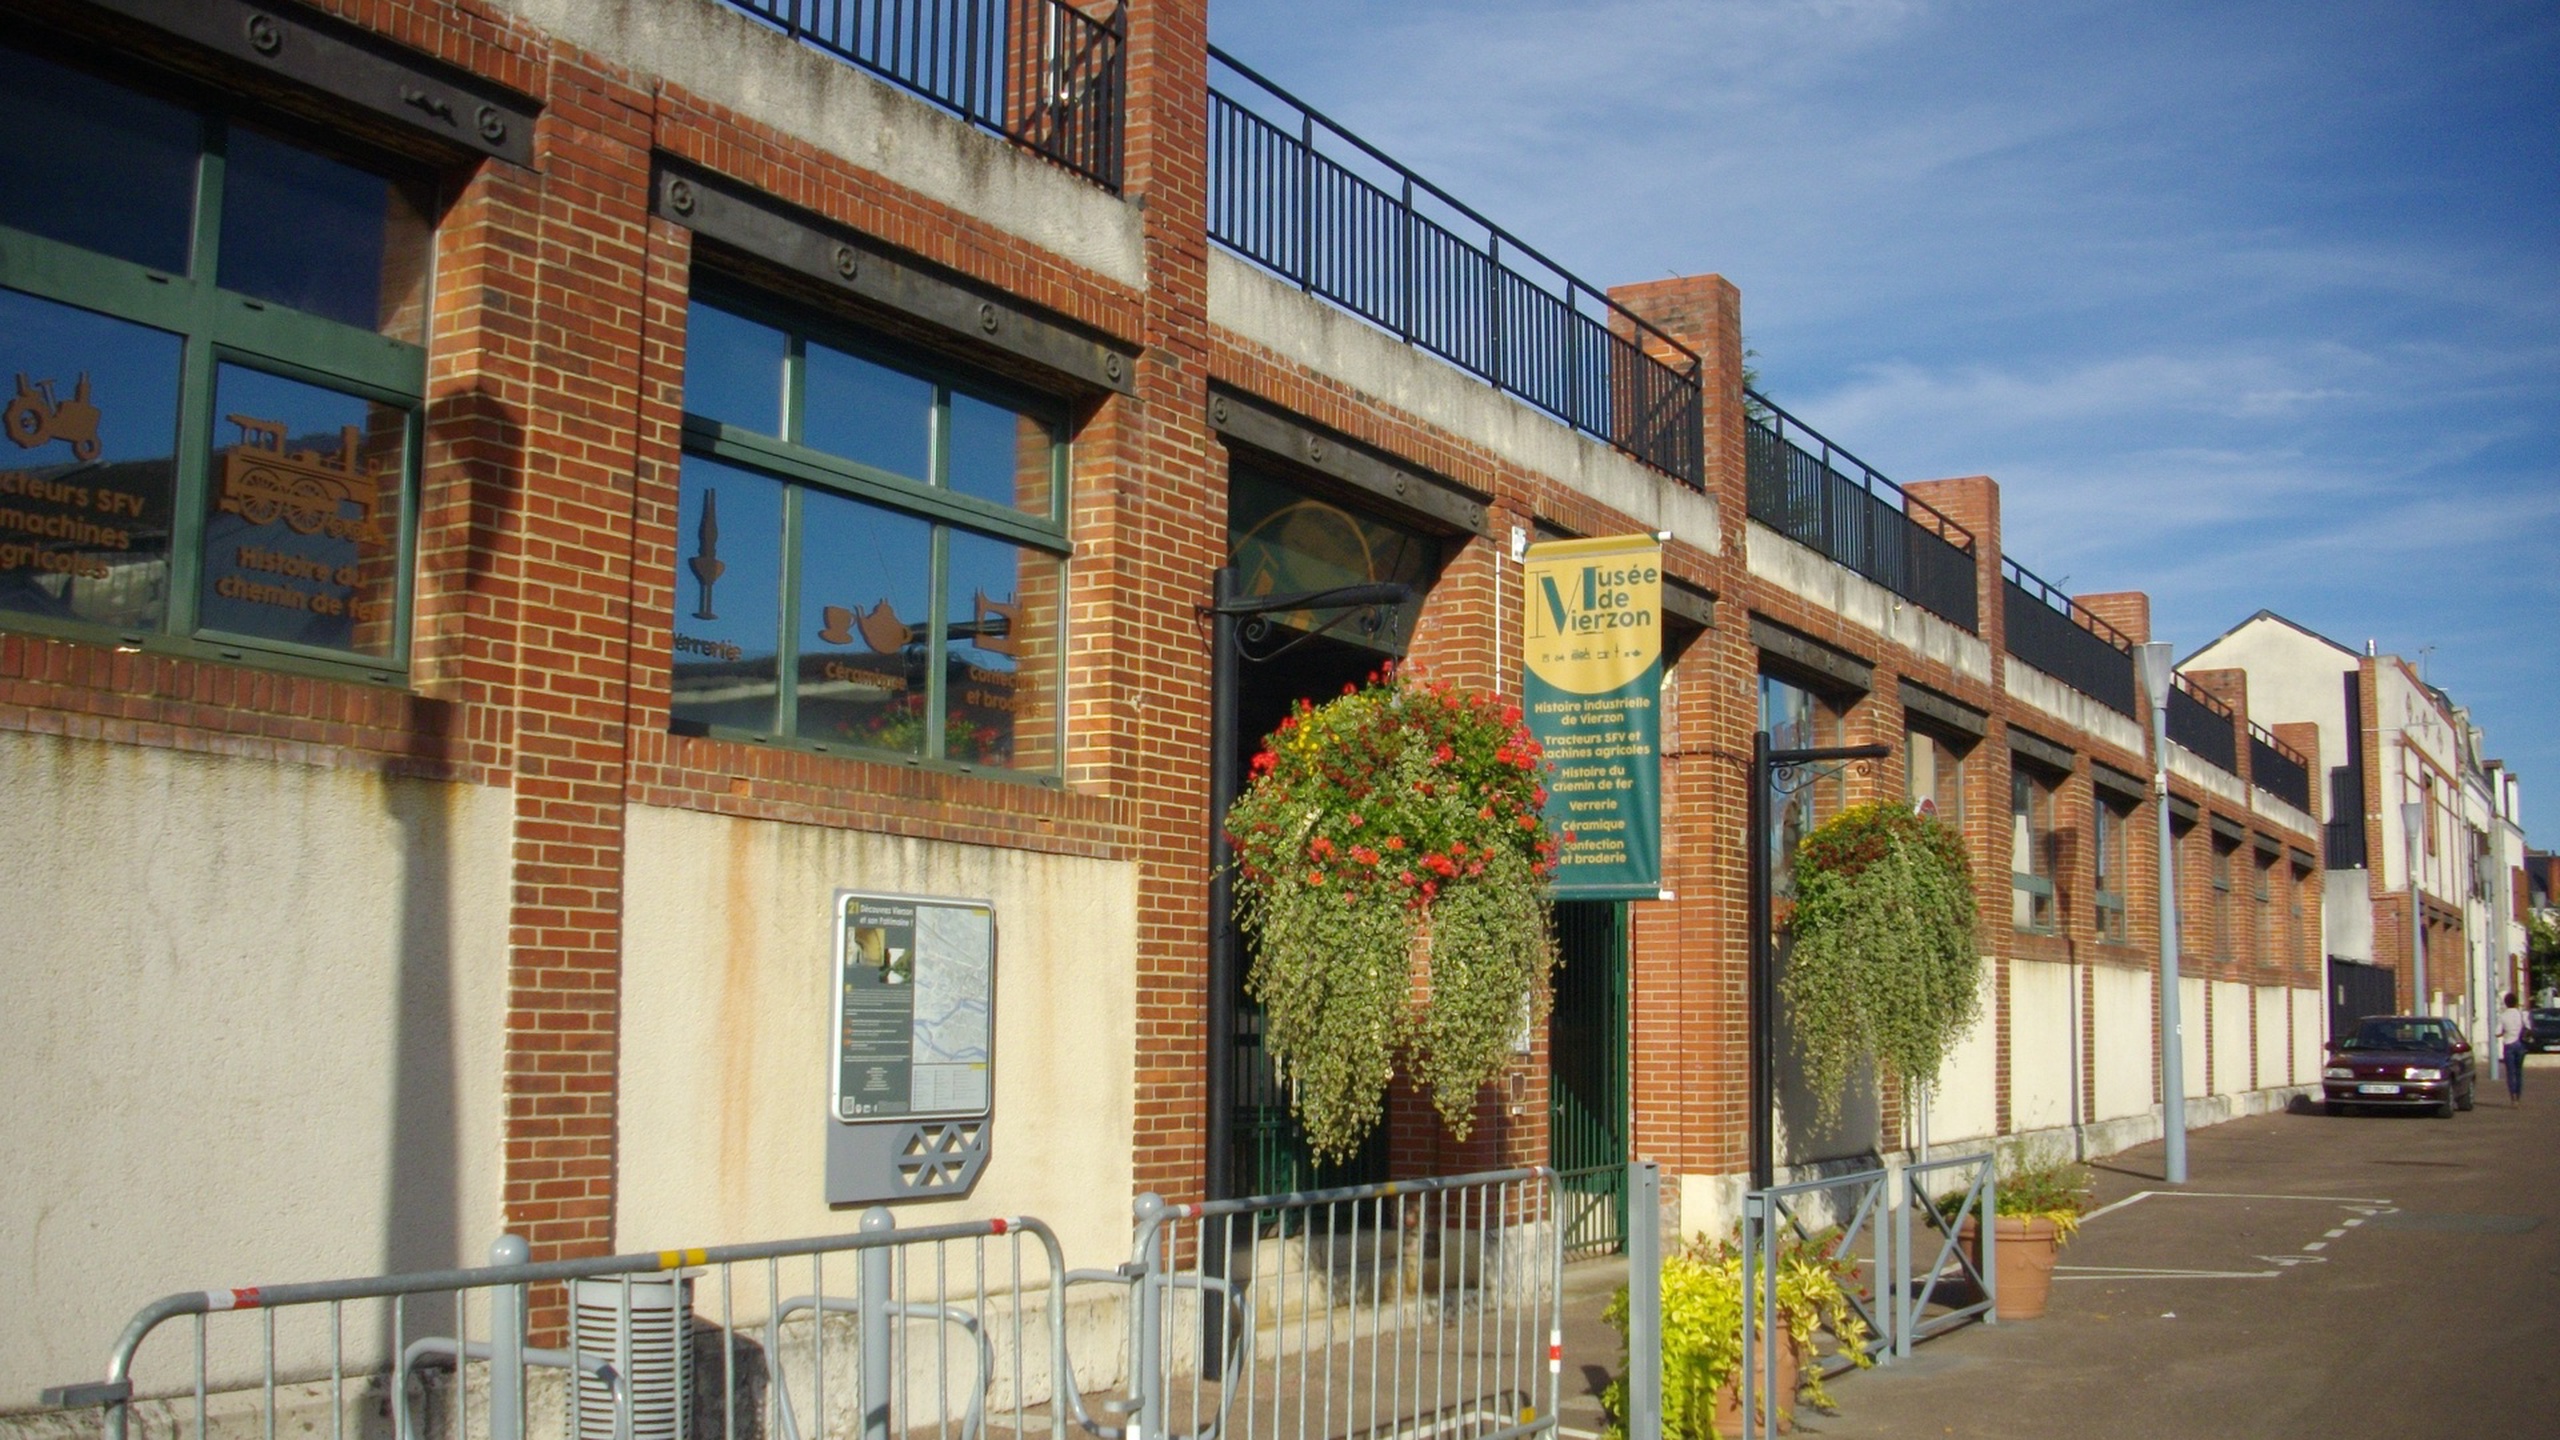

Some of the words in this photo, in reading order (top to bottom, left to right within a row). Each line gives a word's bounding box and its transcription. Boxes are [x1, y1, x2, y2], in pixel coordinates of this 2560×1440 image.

[0, 472, 88, 506] cteurs
[97, 489, 145, 518] SFV
[0, 507, 129, 549] machines
[0, 542, 110, 580] gricoles
[236, 546, 330, 582] Histoire
[334, 566, 369, 591] du
[215, 573, 306, 612] chemin
[308, 592, 343, 617] de
[1598, 589, 1629, 609] de
[673, 632, 741, 662] errerie
[966, 690, 984, 706] et
[1535, 701, 1581, 713] Histoire
[1585, 698, 1650, 710] industrielle
[1562, 715, 1576, 725] de
[1581, 714, 1623, 724] Vierzon
[1545, 735, 1601, 745] Tracteurs
[1605, 732, 1625, 742] SFV
[1629, 731, 1640, 740] et
[1544, 748, 1591, 759] achines
[1596, 745, 1650, 758] agricoles
[1562, 767, 1605, 778] Histoire
[1610, 765, 1624, 775] du
[1553, 780, 1594, 792] chemin
[1598, 779, 1612, 789] de
[1616, 778, 1633, 788] fer
[1570, 799, 1617, 811] Verrerie
[1562, 819, 1624, 831] Céramique
[1561, 855, 1571, 864] et
[1575, 853, 1626, 864] broderie
